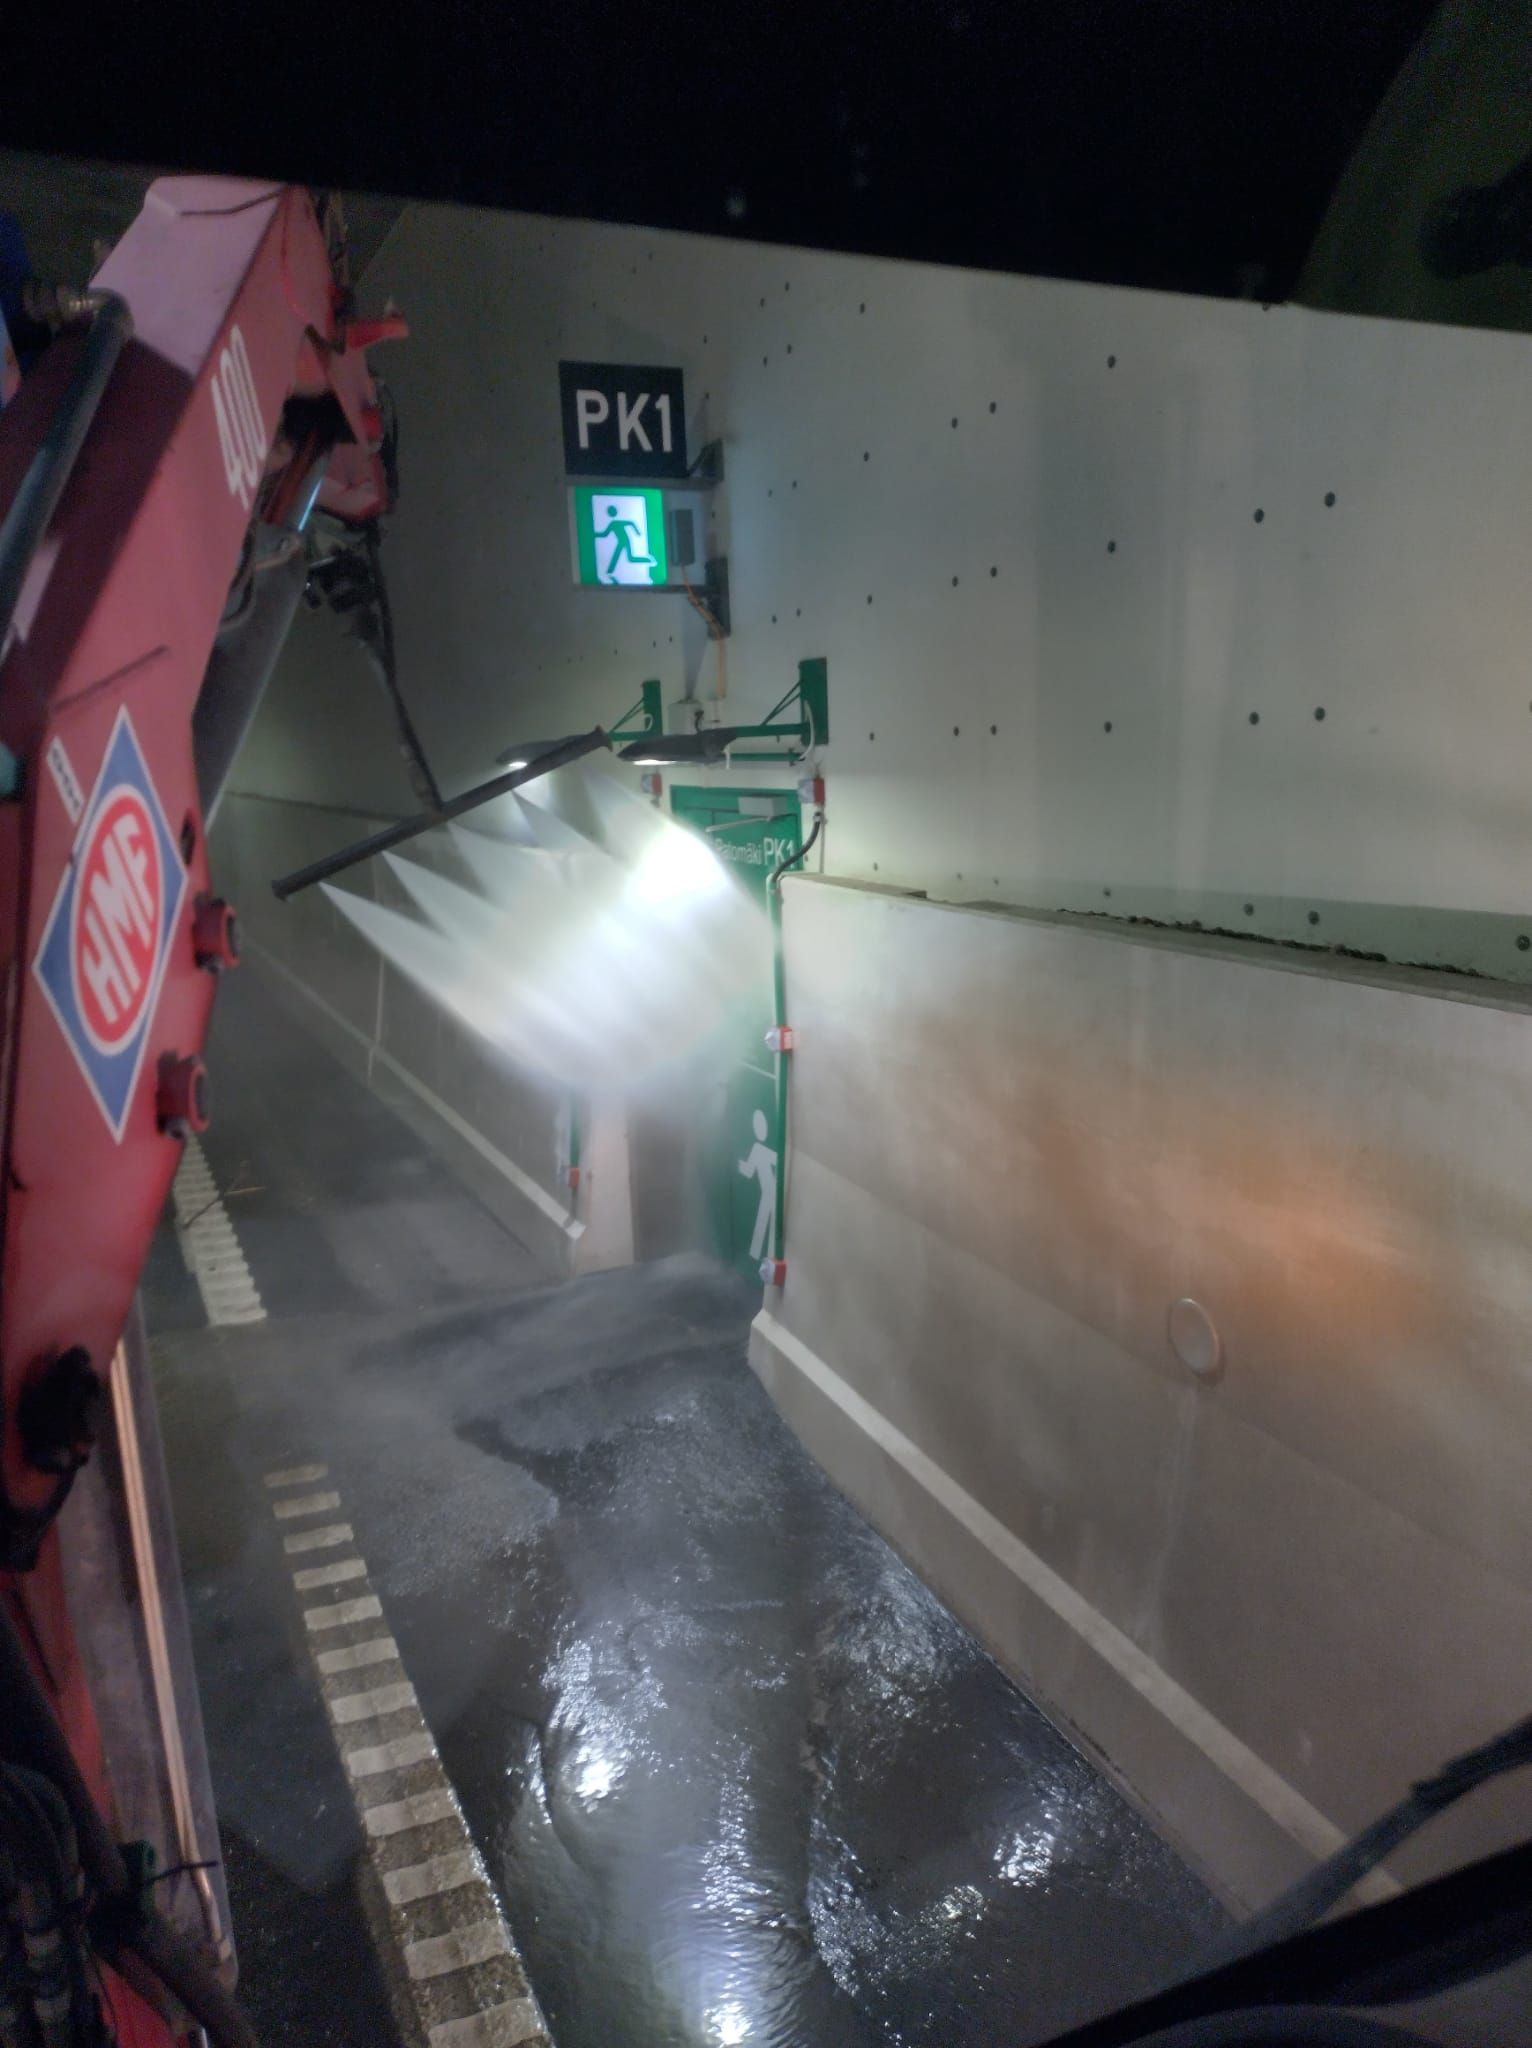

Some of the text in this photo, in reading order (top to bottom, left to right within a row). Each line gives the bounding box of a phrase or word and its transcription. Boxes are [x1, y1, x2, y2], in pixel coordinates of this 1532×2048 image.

[576, 389, 673, 453] PK1
[764, 837, 796, 870] PK1
[80, 813, 155, 1024] HMF
